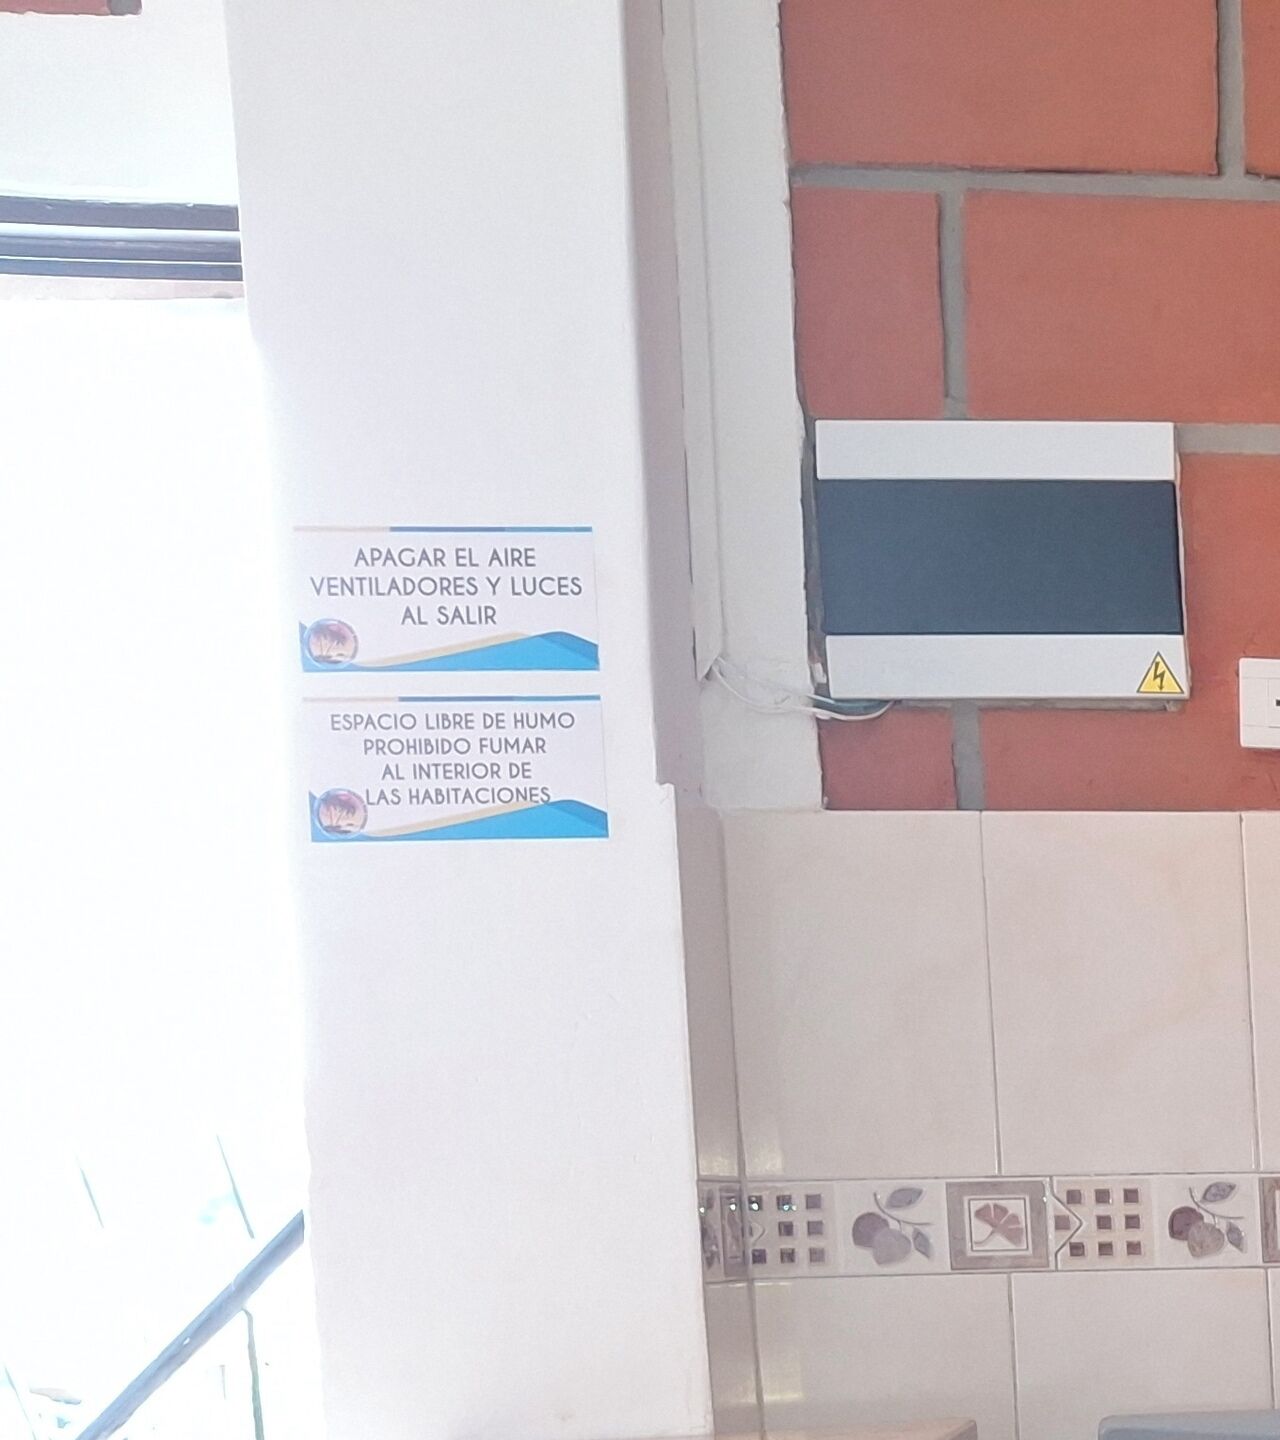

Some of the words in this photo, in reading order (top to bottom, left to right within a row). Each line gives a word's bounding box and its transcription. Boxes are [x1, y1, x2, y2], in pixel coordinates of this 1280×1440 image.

[354, 548, 446, 567] APAGAR
[455, 548, 479, 567] EL
[488, 548, 536, 567] AIRE
[310, 576, 478, 596] VENTILADORES
[487, 577, 502, 595] Y
[511, 576, 582, 595] LUCES
[401, 606, 428, 625] AL
[437, 606, 497, 625] SALIR
[331, 713, 416, 731] ESPACIO
[425, 713, 474, 730] LIBRE
[484, 713, 506, 729] DE
[514, 712, 575, 729] HUMO
[363, 738, 471, 755] PROHIBIDO
[480, 738, 546, 754] FUMAR
[381, 763, 404, 780] AL
[413, 762, 501, 780] INTERIOR
[509, 762, 532, 779] DE
[366, 788, 401, 805] LAS
[409, 787, 551, 804] HABITACIONES
